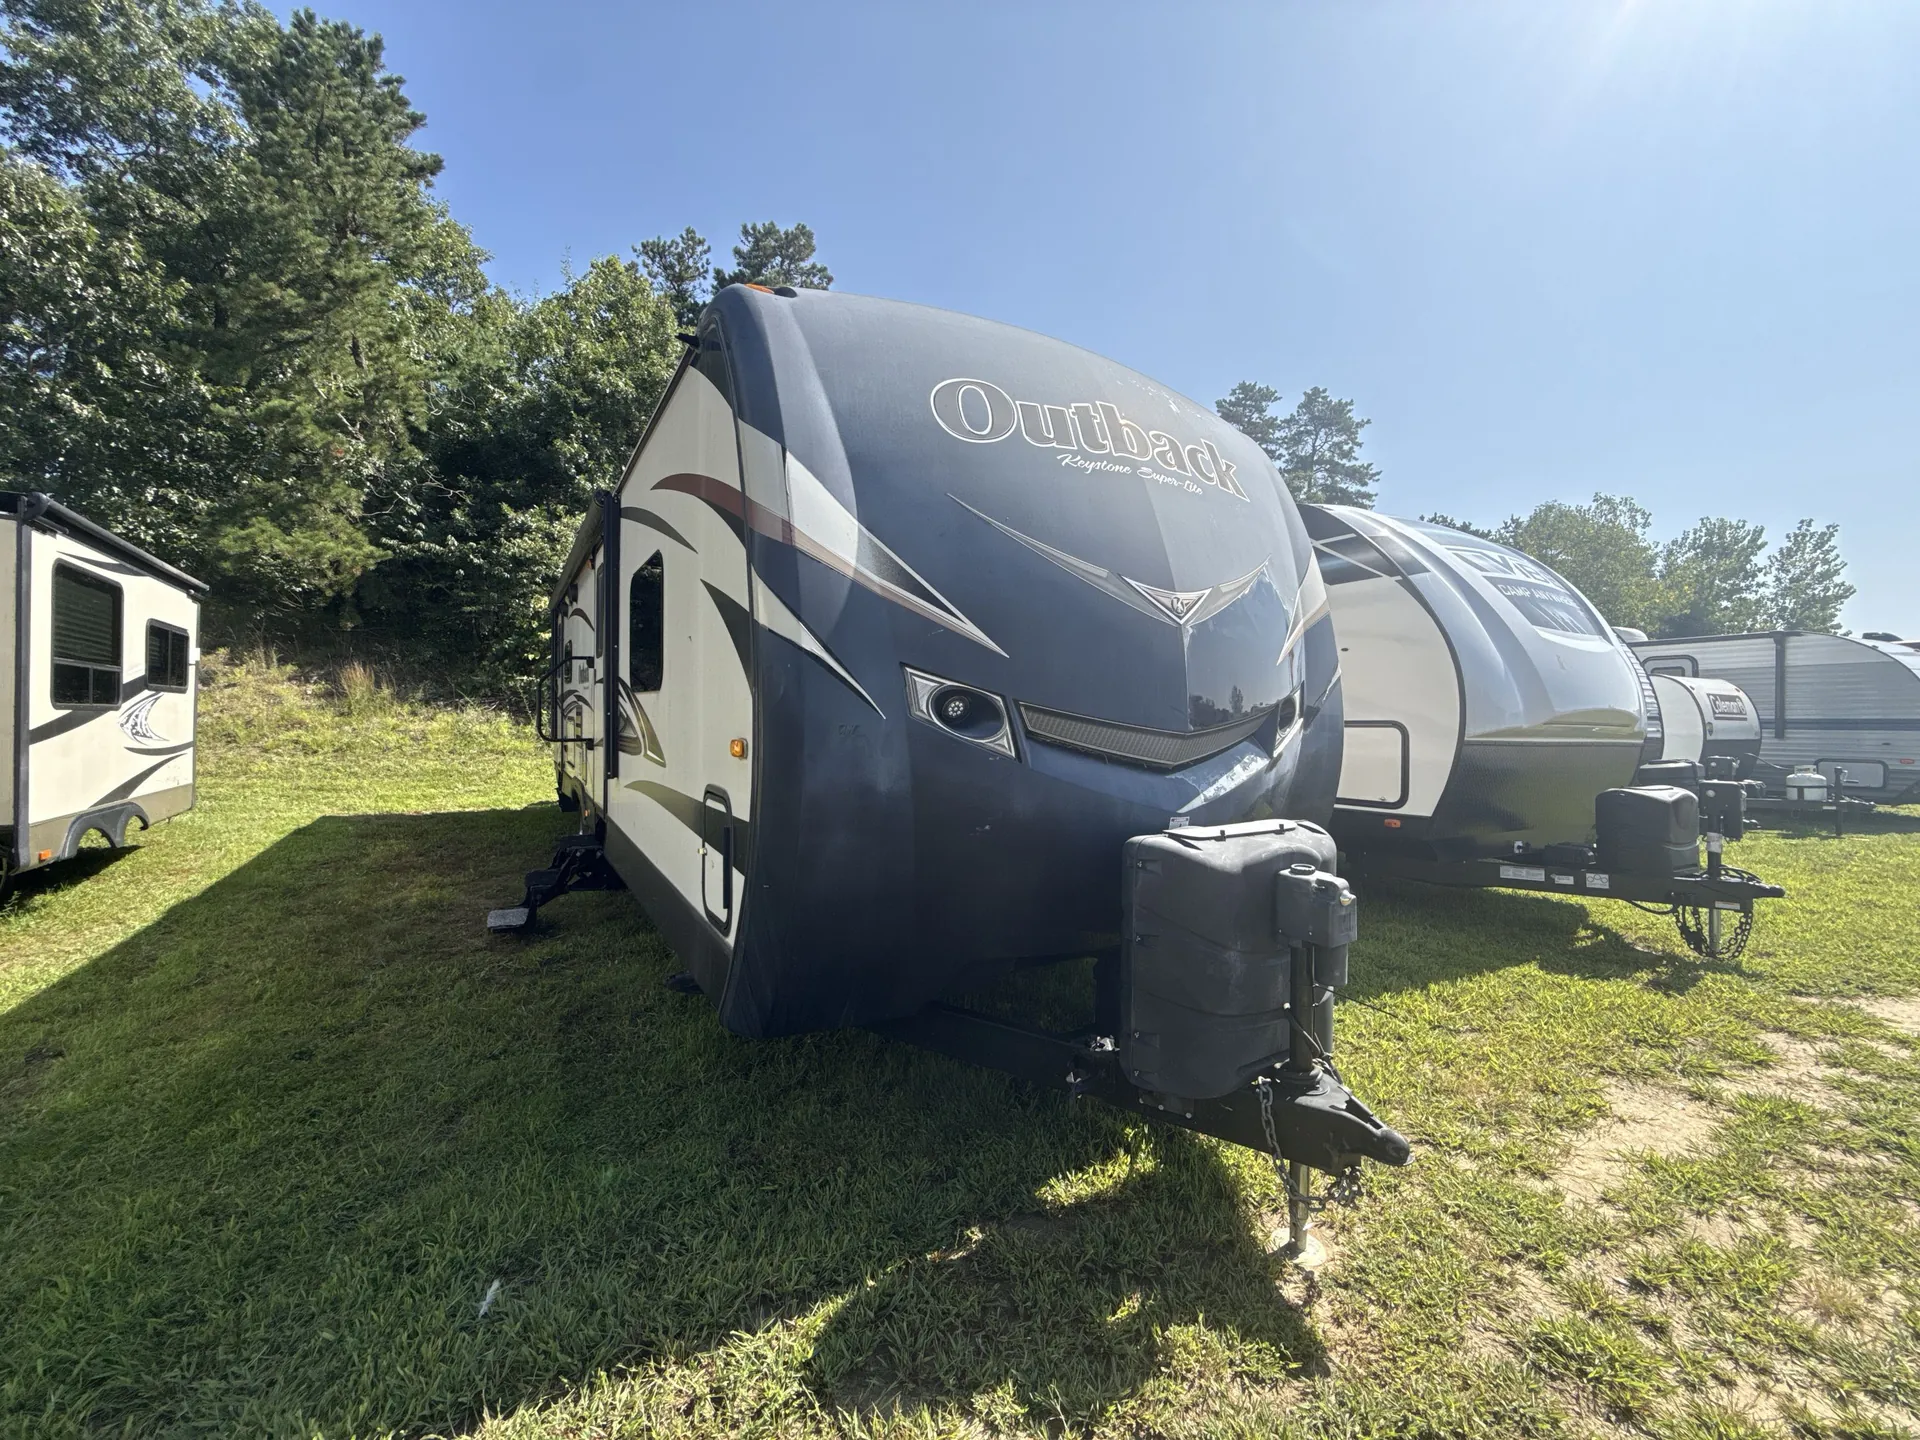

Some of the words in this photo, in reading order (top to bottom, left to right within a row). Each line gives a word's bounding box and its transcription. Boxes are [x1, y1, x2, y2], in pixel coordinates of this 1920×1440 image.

[930, 378, 1251, 502] Outback
[1056, 453, 1133, 474] Keystone
[1497, 584, 1531, 598] CAMP
[1709, 695, 1742, 714] Coleman
